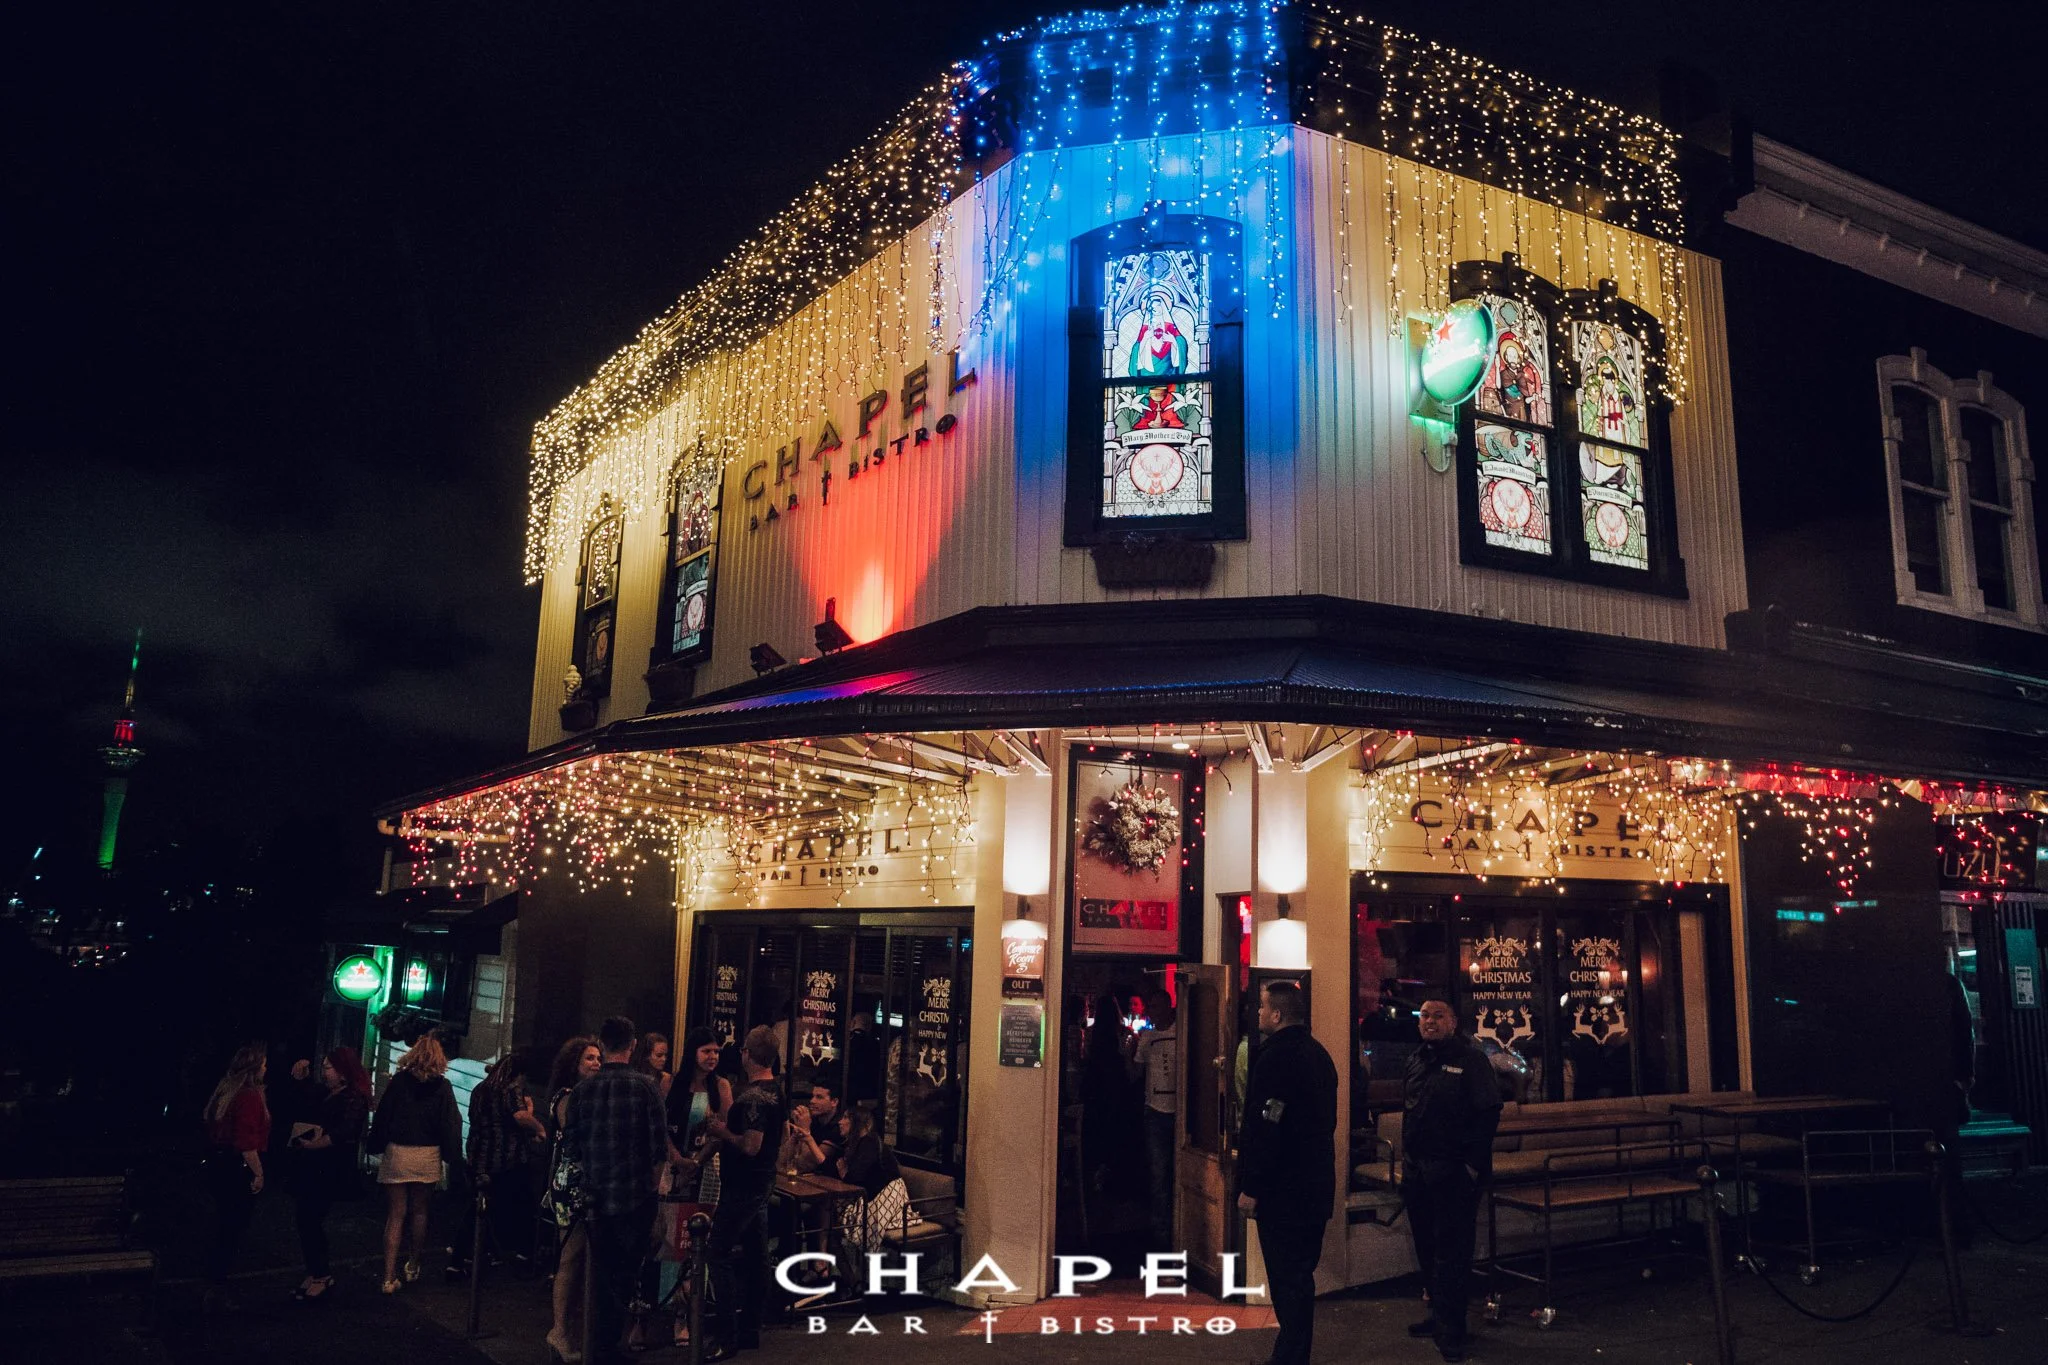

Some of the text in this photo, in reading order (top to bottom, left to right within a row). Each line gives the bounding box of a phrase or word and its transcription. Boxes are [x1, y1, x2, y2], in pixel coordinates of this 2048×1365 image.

[742, 346, 977, 500] CHAPEL
[749, 413, 957, 531] BAR BISTRO
[748, 829, 899, 863] CHAPEL
[1560, 844, 1651, 858] BISTRO
[761, 865, 879, 880] BAR BISTRO
[1485, 957, 1519, 968] MERRY
[1581, 957, 1612, 968] MERRY
[1473, 971, 1532, 984] CHRISTMAS
[1012, 980, 1031, 989] OUT
[810, 987, 830, 998] MERRY
[1571, 990, 1592, 998] HAPPY
[803, 1000, 836, 1012] CHRISTMAS
[919, 1030, 934, 1038] HAPPY
